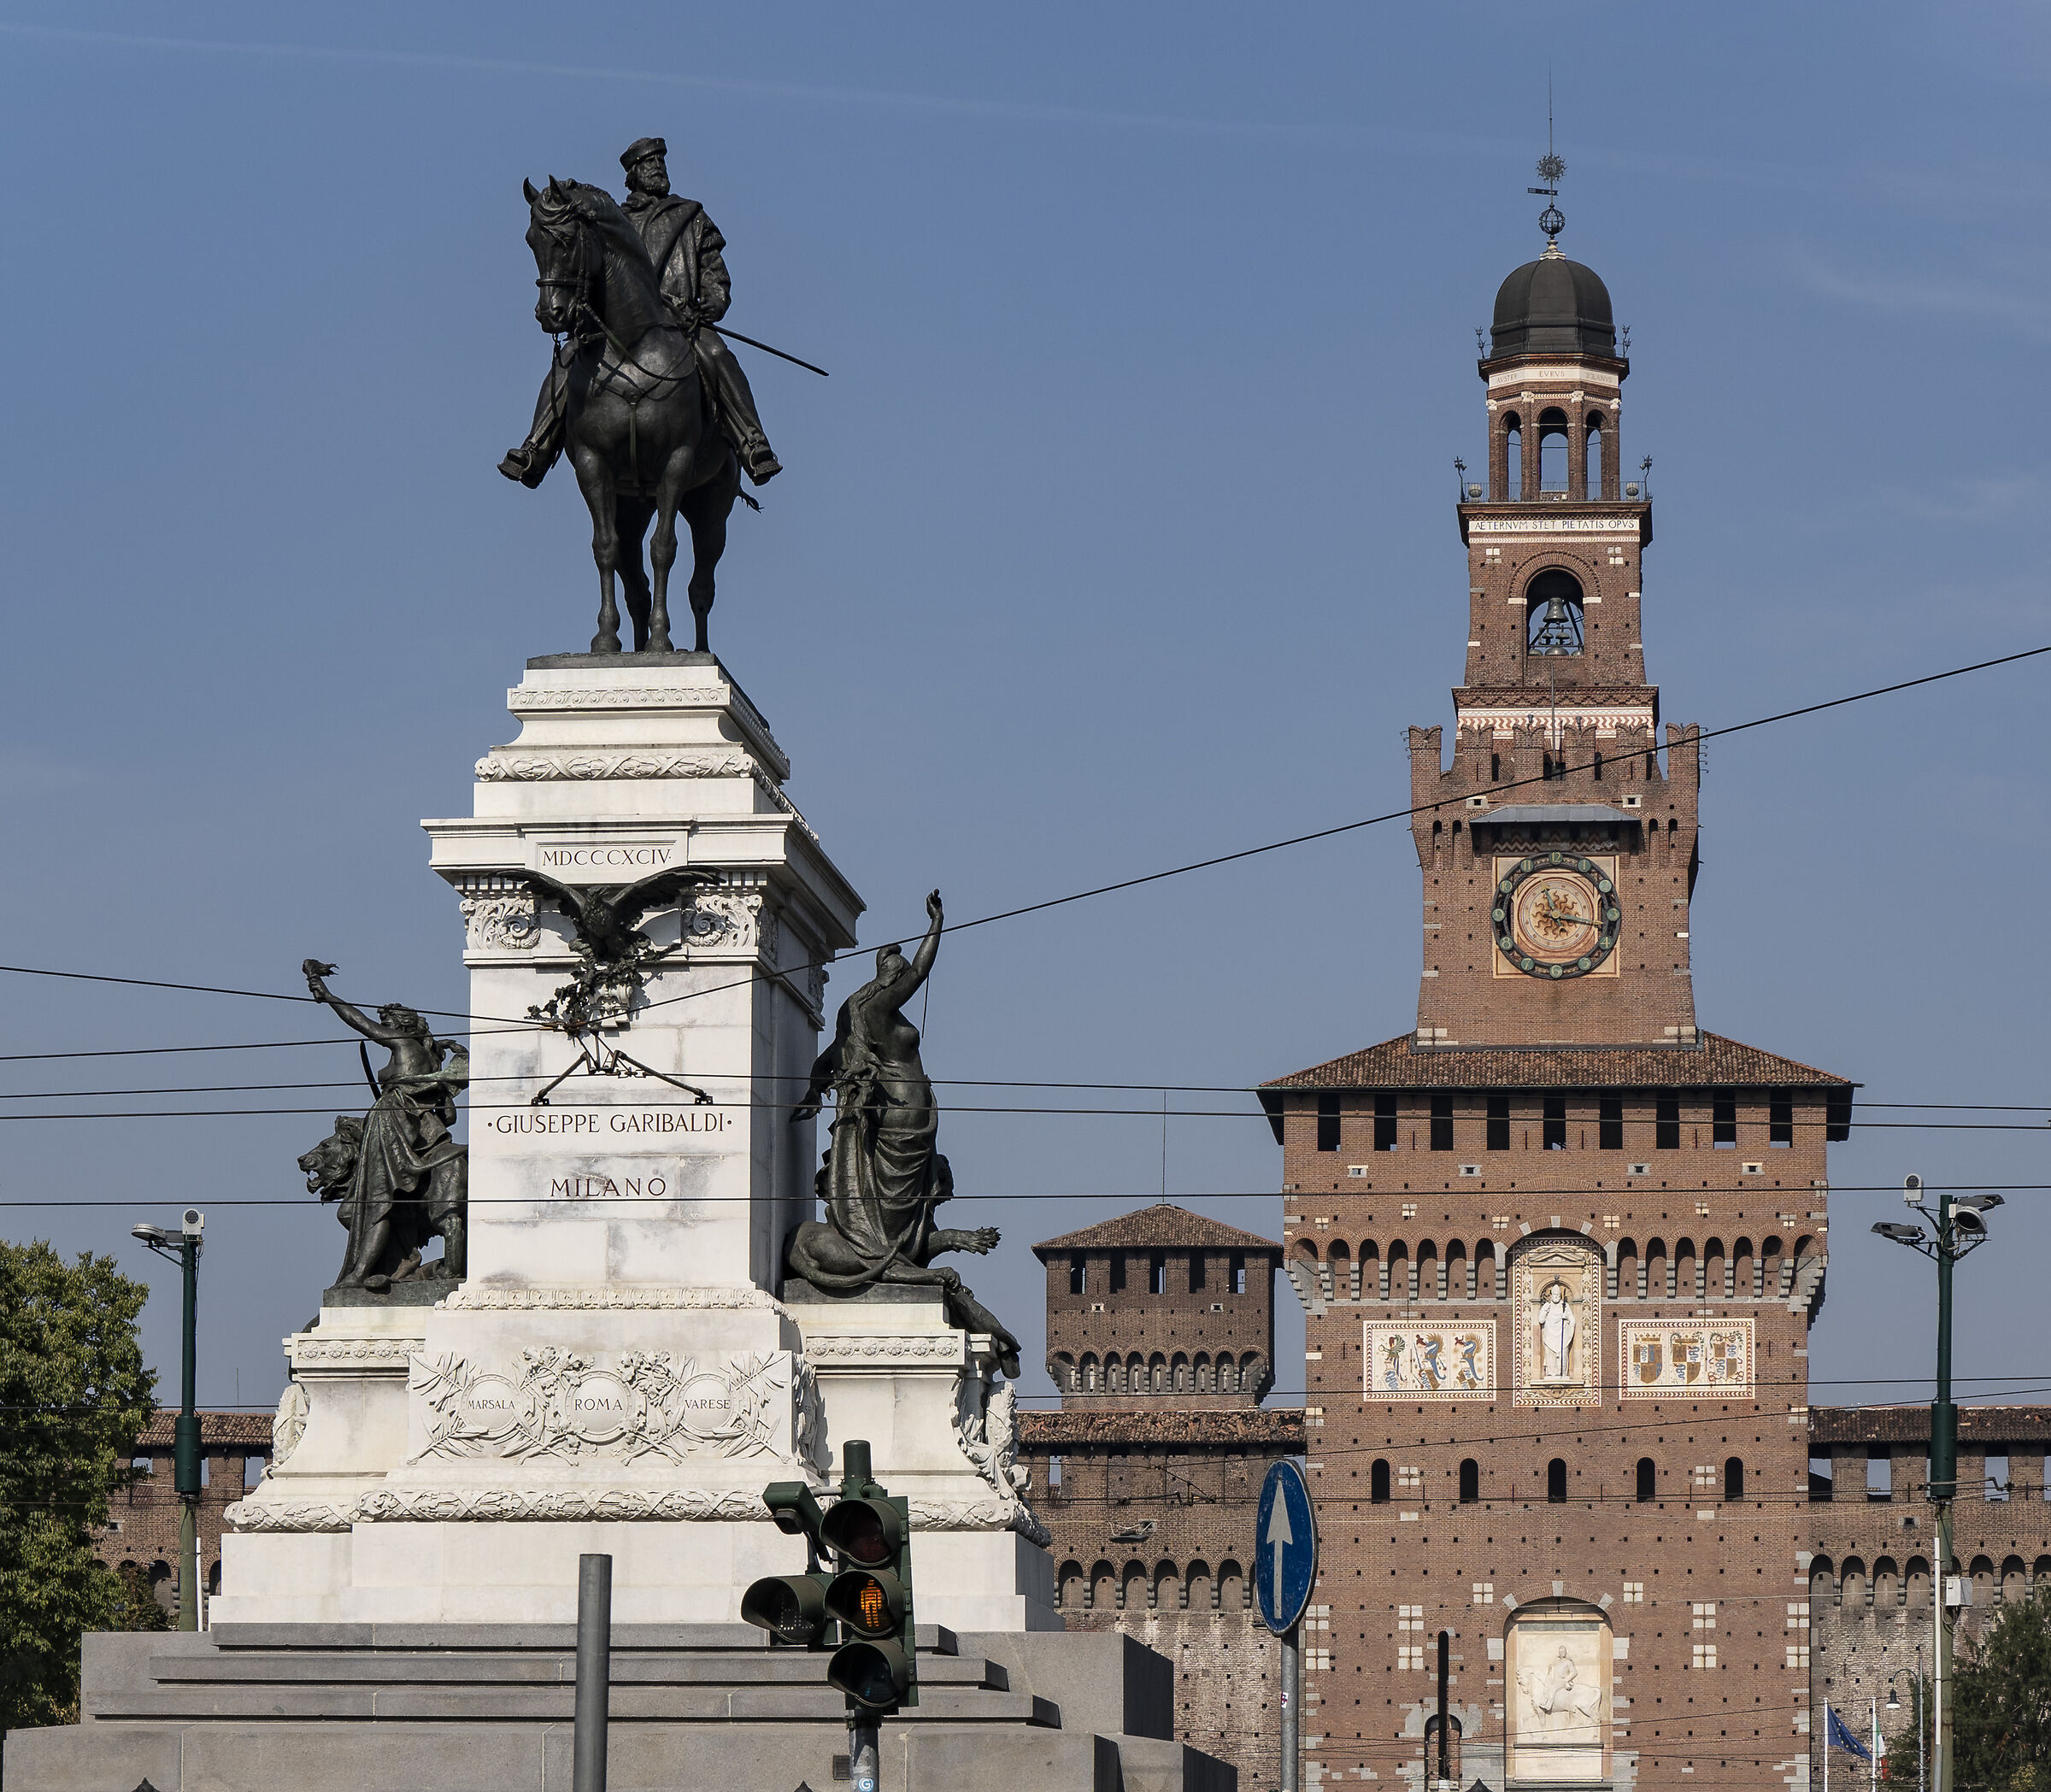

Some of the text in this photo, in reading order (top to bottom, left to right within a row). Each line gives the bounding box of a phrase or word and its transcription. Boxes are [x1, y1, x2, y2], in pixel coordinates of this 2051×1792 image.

[1532, 520, 1555, 530] STET
[1562, 520, 1604, 529] PIETATIS
[1608, 520, 1635, 529] OPVS
[1551, 852, 1561, 863] 12
[1523, 861, 1531, 871] 11
[1502, 881, 1513, 892] 10
[1496, 909, 1503, 920] 9
[1611, 909, 1618, 920] 3
[1502, 937, 1511, 948] 8
[1601, 937, 1610, 949] 4
[1525, 959, 1531, 970] 7
[1581, 958, 1589, 969] 5
[1552, 966, 1560, 976] 6
[550, 1178, 667, 1196] MILANO
[467, 1400, 515, 1410] MARSALA
[574, 1398, 623, 1411] ROMA
[685, 1398, 731, 1410] VARESE
